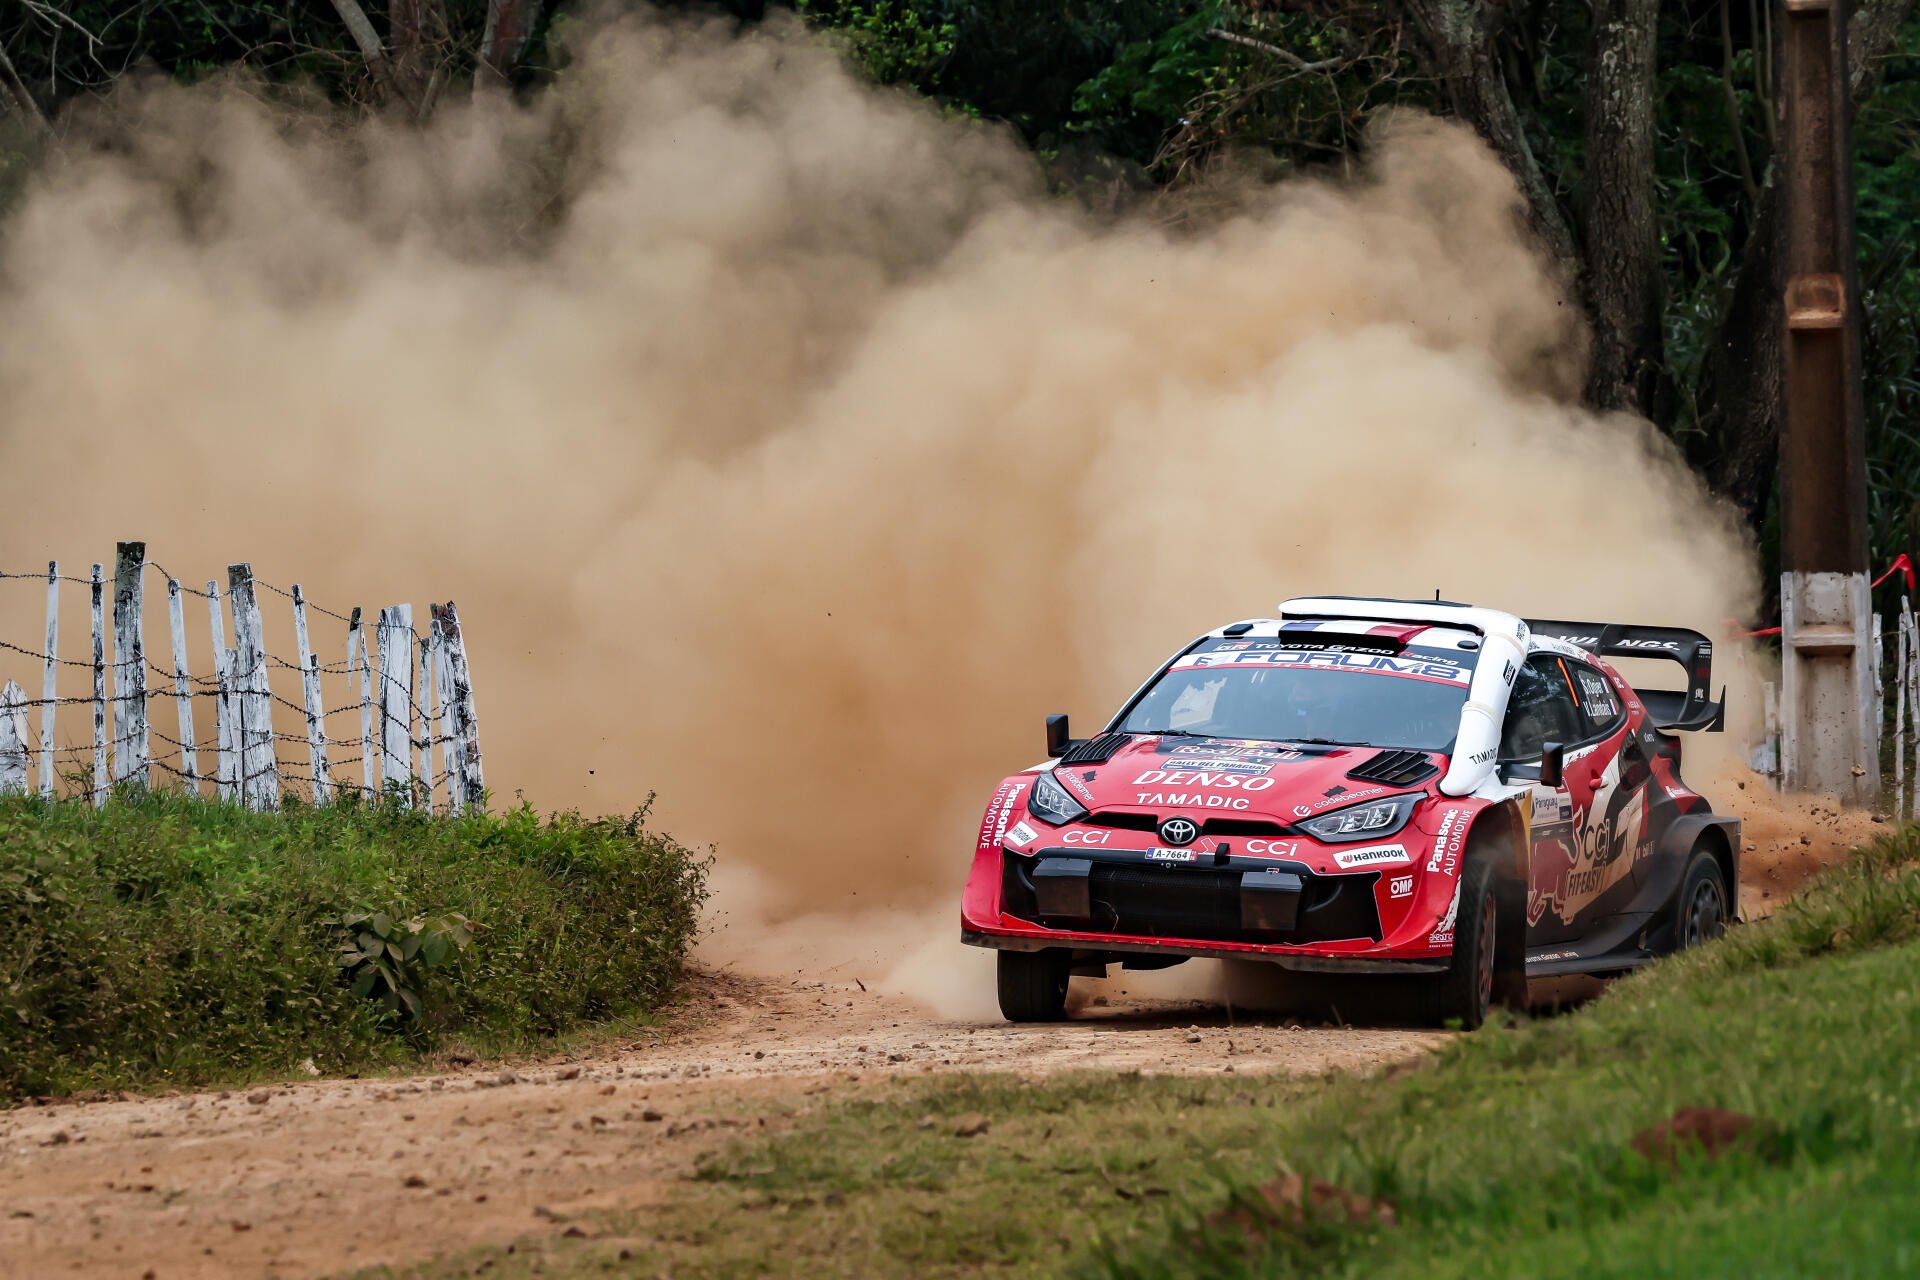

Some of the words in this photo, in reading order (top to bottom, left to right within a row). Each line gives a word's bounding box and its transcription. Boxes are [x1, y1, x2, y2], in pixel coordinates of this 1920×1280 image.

[1234, 651, 1461, 679] FORUM8
[1399, 651, 1460, 665] Racing
[1132, 770, 1275, 791] DENSO
[1136, 793, 1250, 810] TAMADIC
[1314, 787, 1385, 808] codebeamer
[980, 783, 1011, 849] AUTOMOTIVE
[993, 783, 1027, 847] Panasonic
[1427, 808, 1458, 873] Panasonic
[1443, 809, 1474, 876] AUTOMOTIVE
[1155, 847, 1188, 859] A-7664
[1390, 878, 1413, 894] OMP
